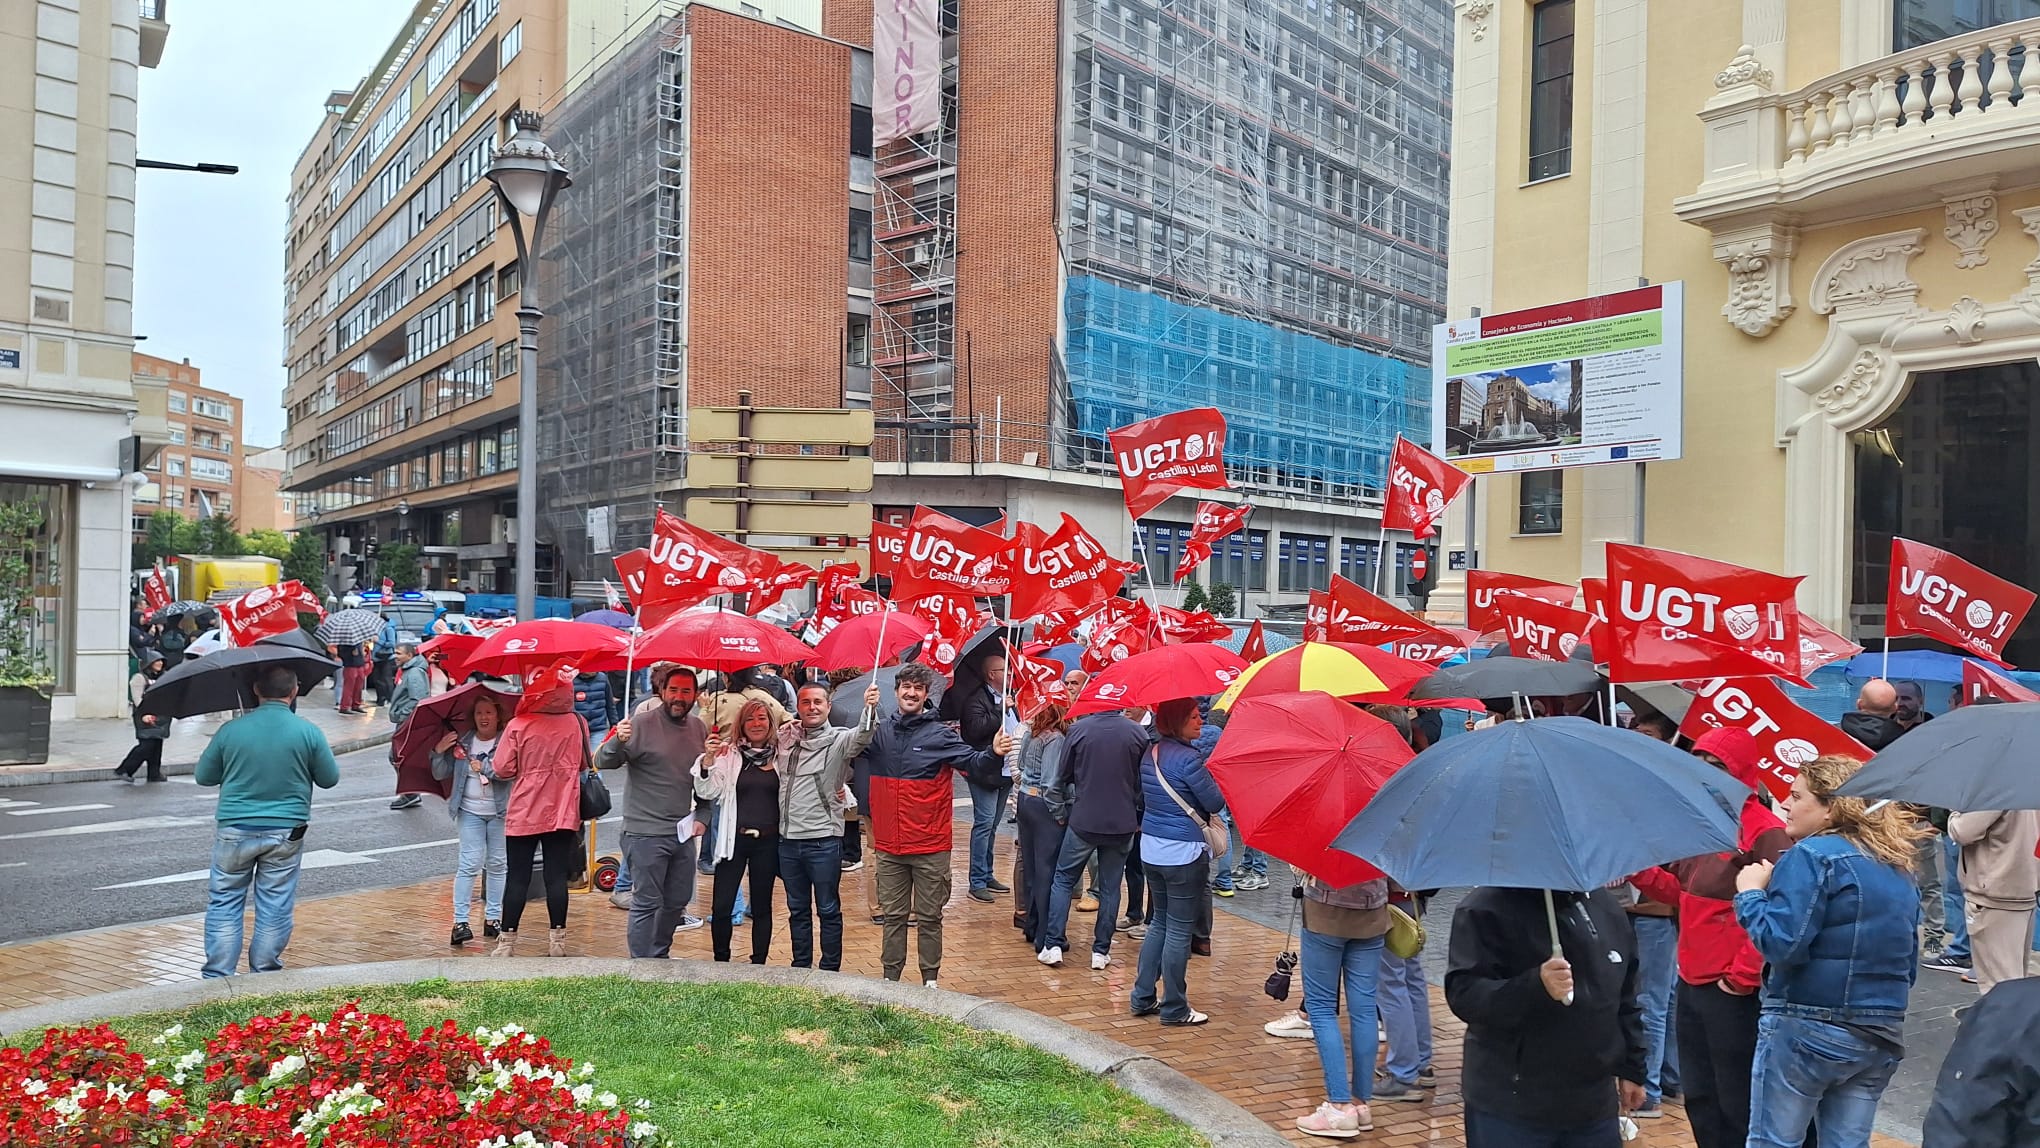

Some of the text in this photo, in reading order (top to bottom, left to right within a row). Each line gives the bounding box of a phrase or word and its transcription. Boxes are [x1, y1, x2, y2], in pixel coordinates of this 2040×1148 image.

[1482, 326, 1508, 337] Consejería
[1517, 320, 1542, 329] Economía
[1548, 316, 1572, 325] Hacienda
[1120, 438, 1182, 478] UGT
[1148, 462, 1218, 481] Castilla y León
[649, 534, 719, 580] UGT
[878, 536, 905, 554] UG
[909, 531, 976, 576] UGT
[1024, 541, 1074, 575] UGT
[929, 567, 1010, 586] Castilla y León
[1049, 556, 1108, 589] Castilla y León
[1620, 580, 1721, 633] UGT
[1900, 566, 1967, 614] UGT
[258, 600, 284, 616] León
[1308, 605, 1328, 622] UG
[720, 637, 744, 645] UGT
[1507, 615, 1555, 650] UGT
[1698, 678, 1781, 736] UGT
[1757, 757, 1795, 784] y Le
